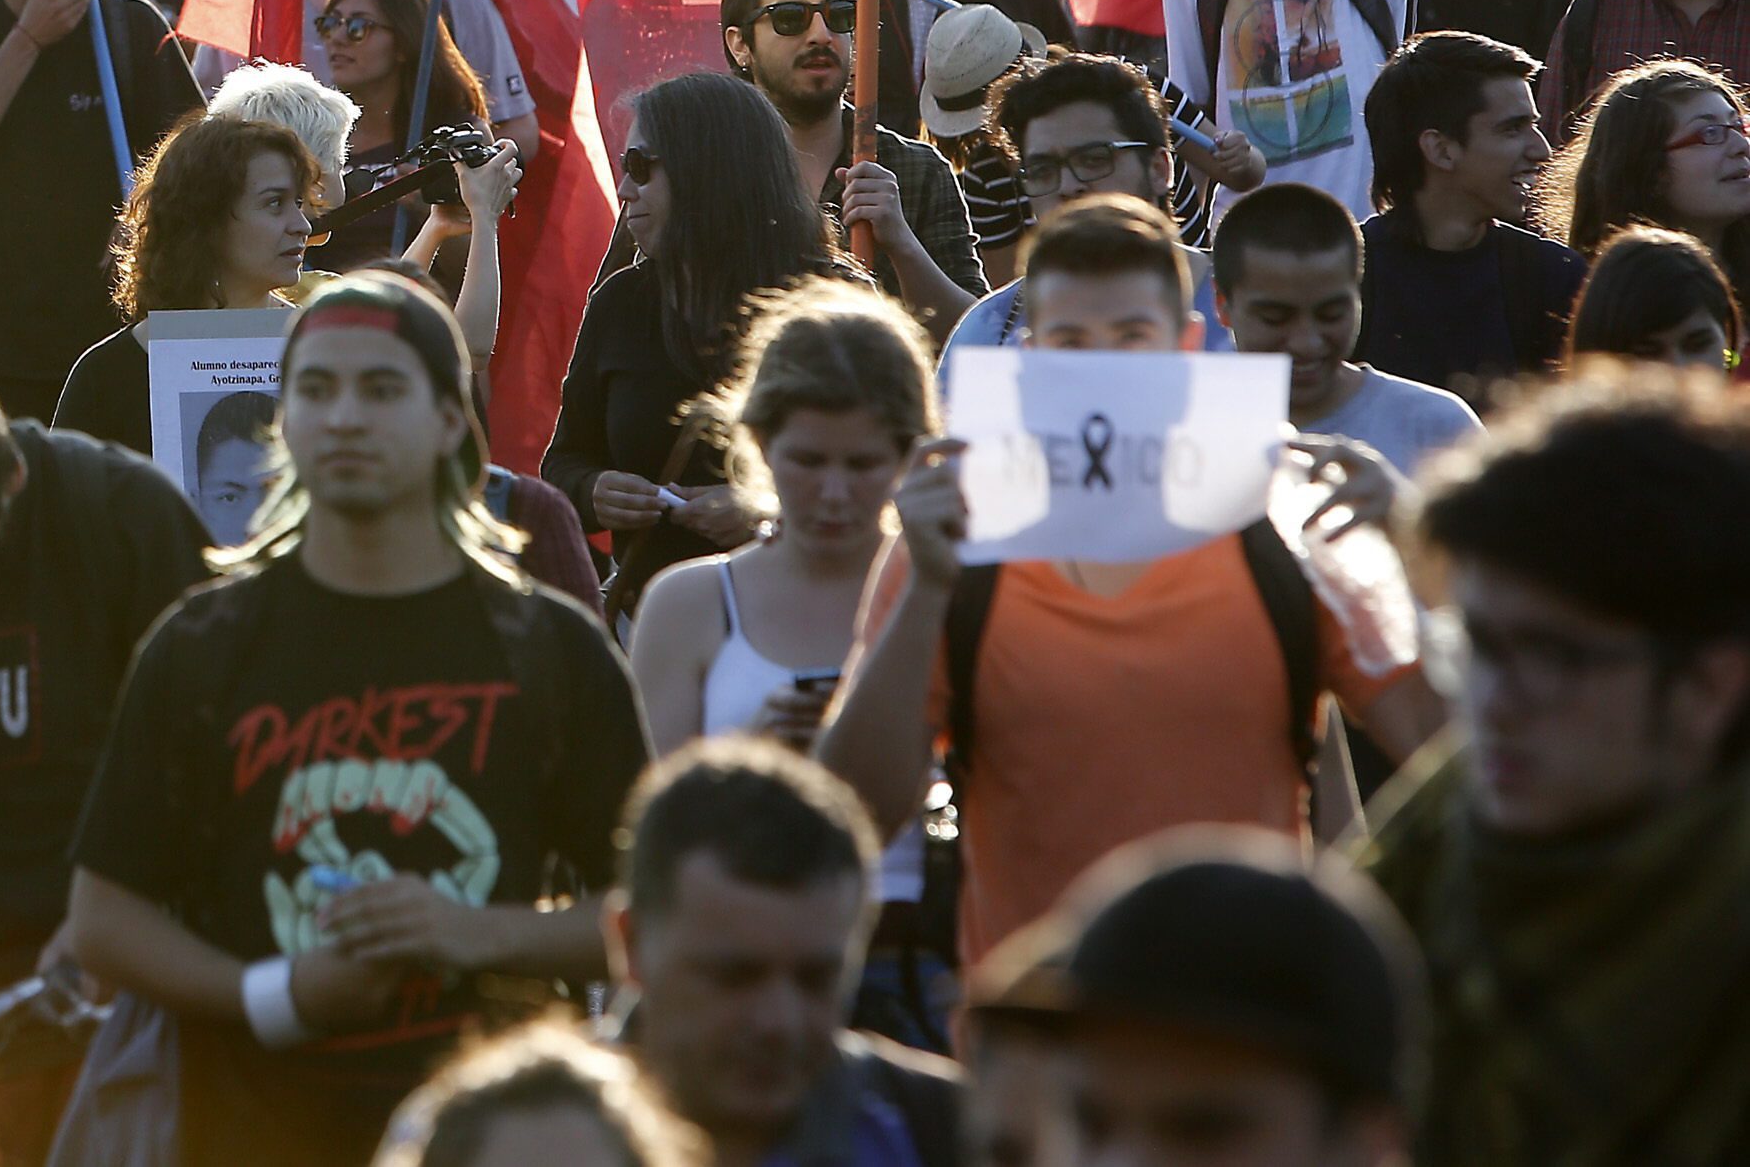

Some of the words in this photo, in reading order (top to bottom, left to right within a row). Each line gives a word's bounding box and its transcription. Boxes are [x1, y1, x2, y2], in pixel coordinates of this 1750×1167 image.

[190, 360, 227, 371] Alumno
[230, 359, 279, 373] desaparec
[211, 374, 266, 386] Ayotzinapa,
[228, 682, 520, 794] DARKEST
